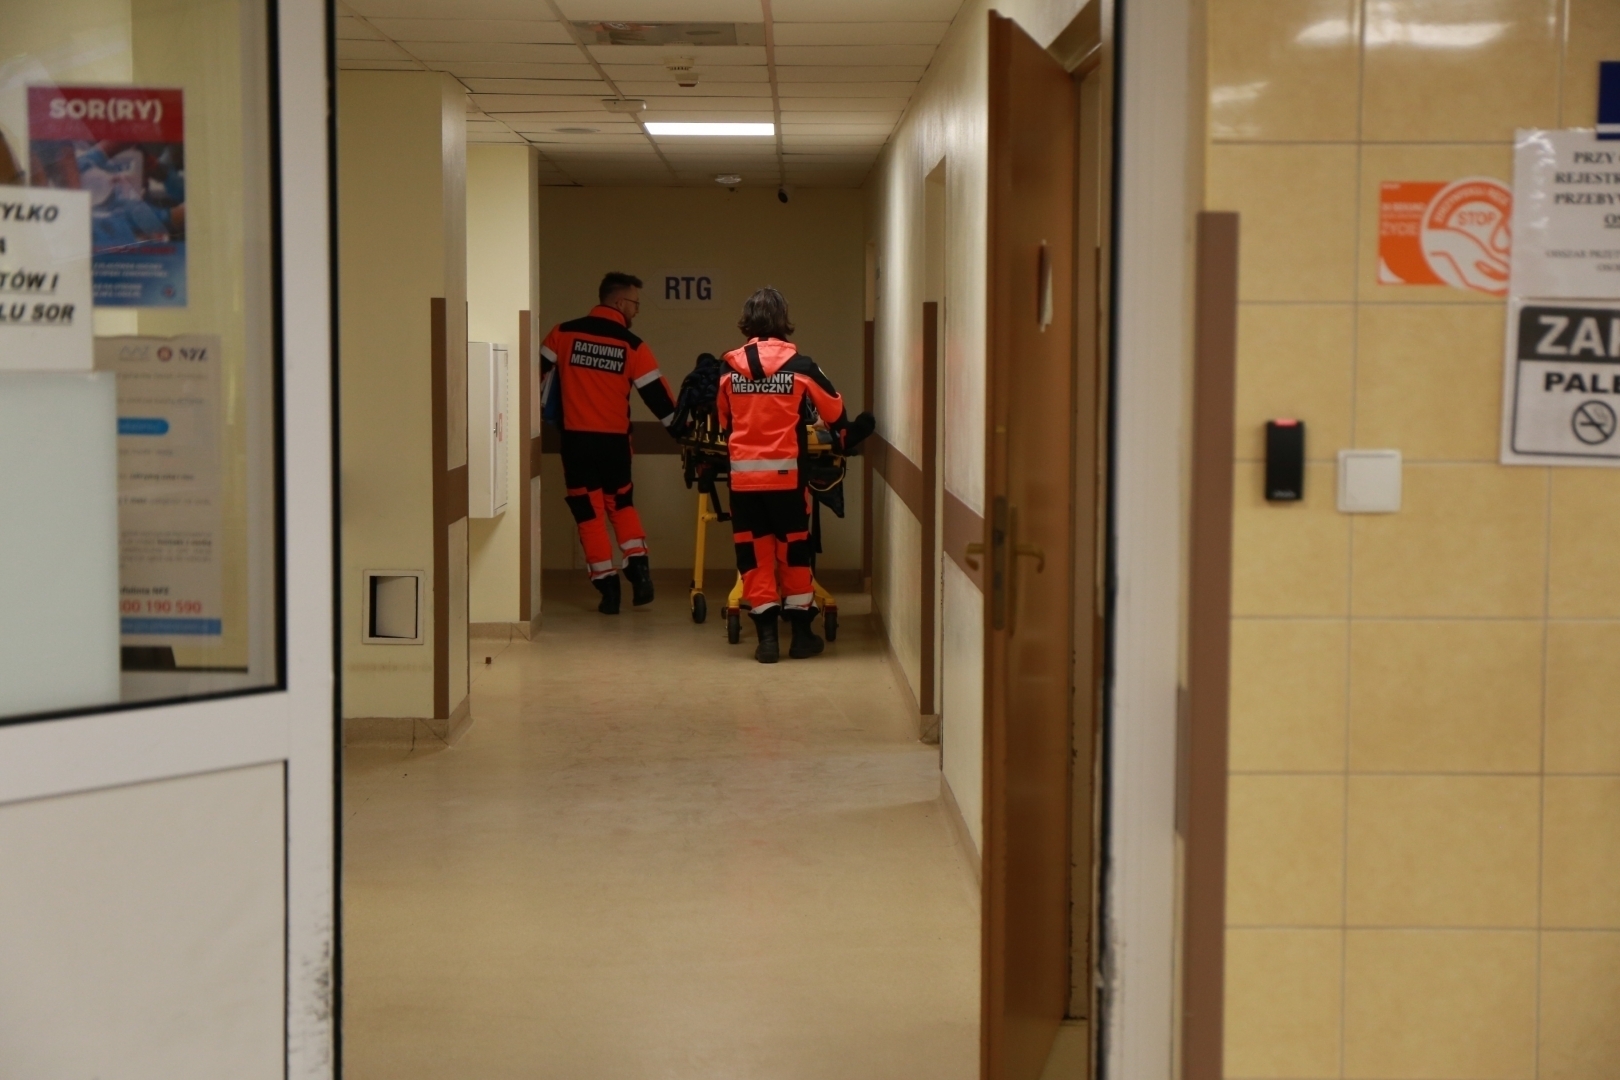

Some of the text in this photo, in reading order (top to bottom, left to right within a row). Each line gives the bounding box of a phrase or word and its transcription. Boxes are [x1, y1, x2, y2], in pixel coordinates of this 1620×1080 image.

[50, 98, 163, 123] SOR(RY)
[1573, 151, 1616, 164] PRZY
[1555, 193, 1620, 205] PRZEBY
[0, 203, 59, 222] YLKO
[1458, 211, 1497, 226] STOP
[665, 276, 712, 300] RTG
[31, 303, 75, 323] SOR
[574, 340, 625, 359] RATOWNIK
[571, 353, 624, 372] MEDYCZNY
[732, 383, 793, 394] MEDYCZNY
[146, 599, 172, 614] 190
[176, 599, 203, 615] 590
